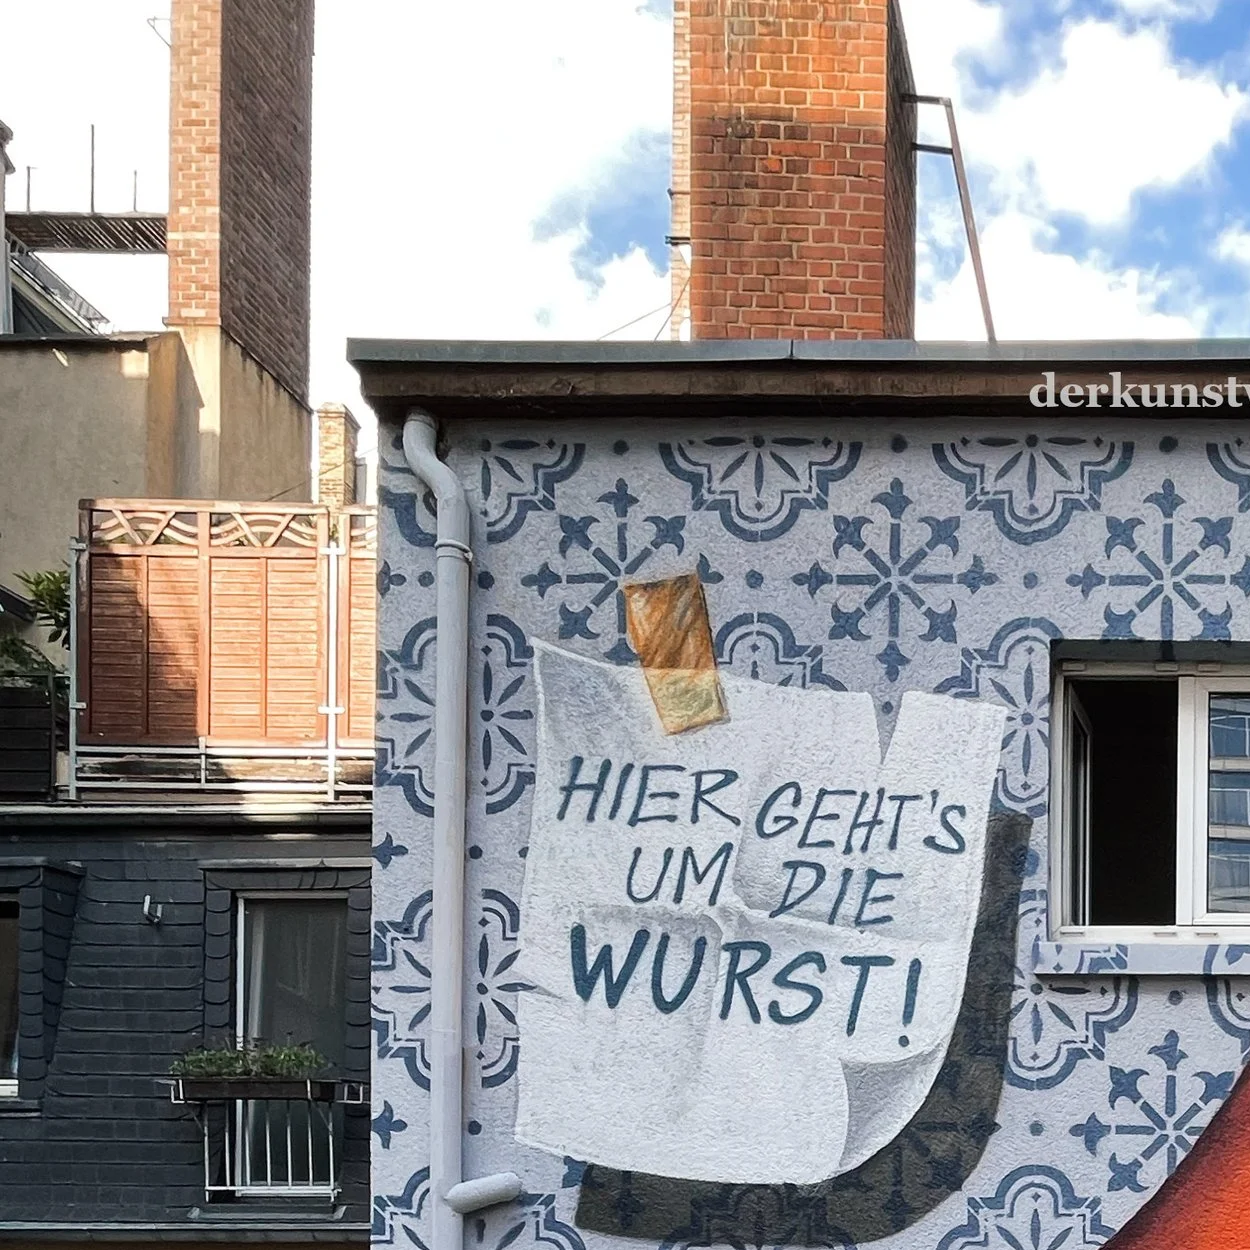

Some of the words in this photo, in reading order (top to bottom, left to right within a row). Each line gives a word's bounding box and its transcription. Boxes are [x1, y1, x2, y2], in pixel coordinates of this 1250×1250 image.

[556, 755, 741, 828] HIER
[754, 781, 967, 855] GEHT'S
[626, 842, 734, 907] UM
[768, 860, 905, 928] DIE
[569, 923, 923, 1048] WURST!
